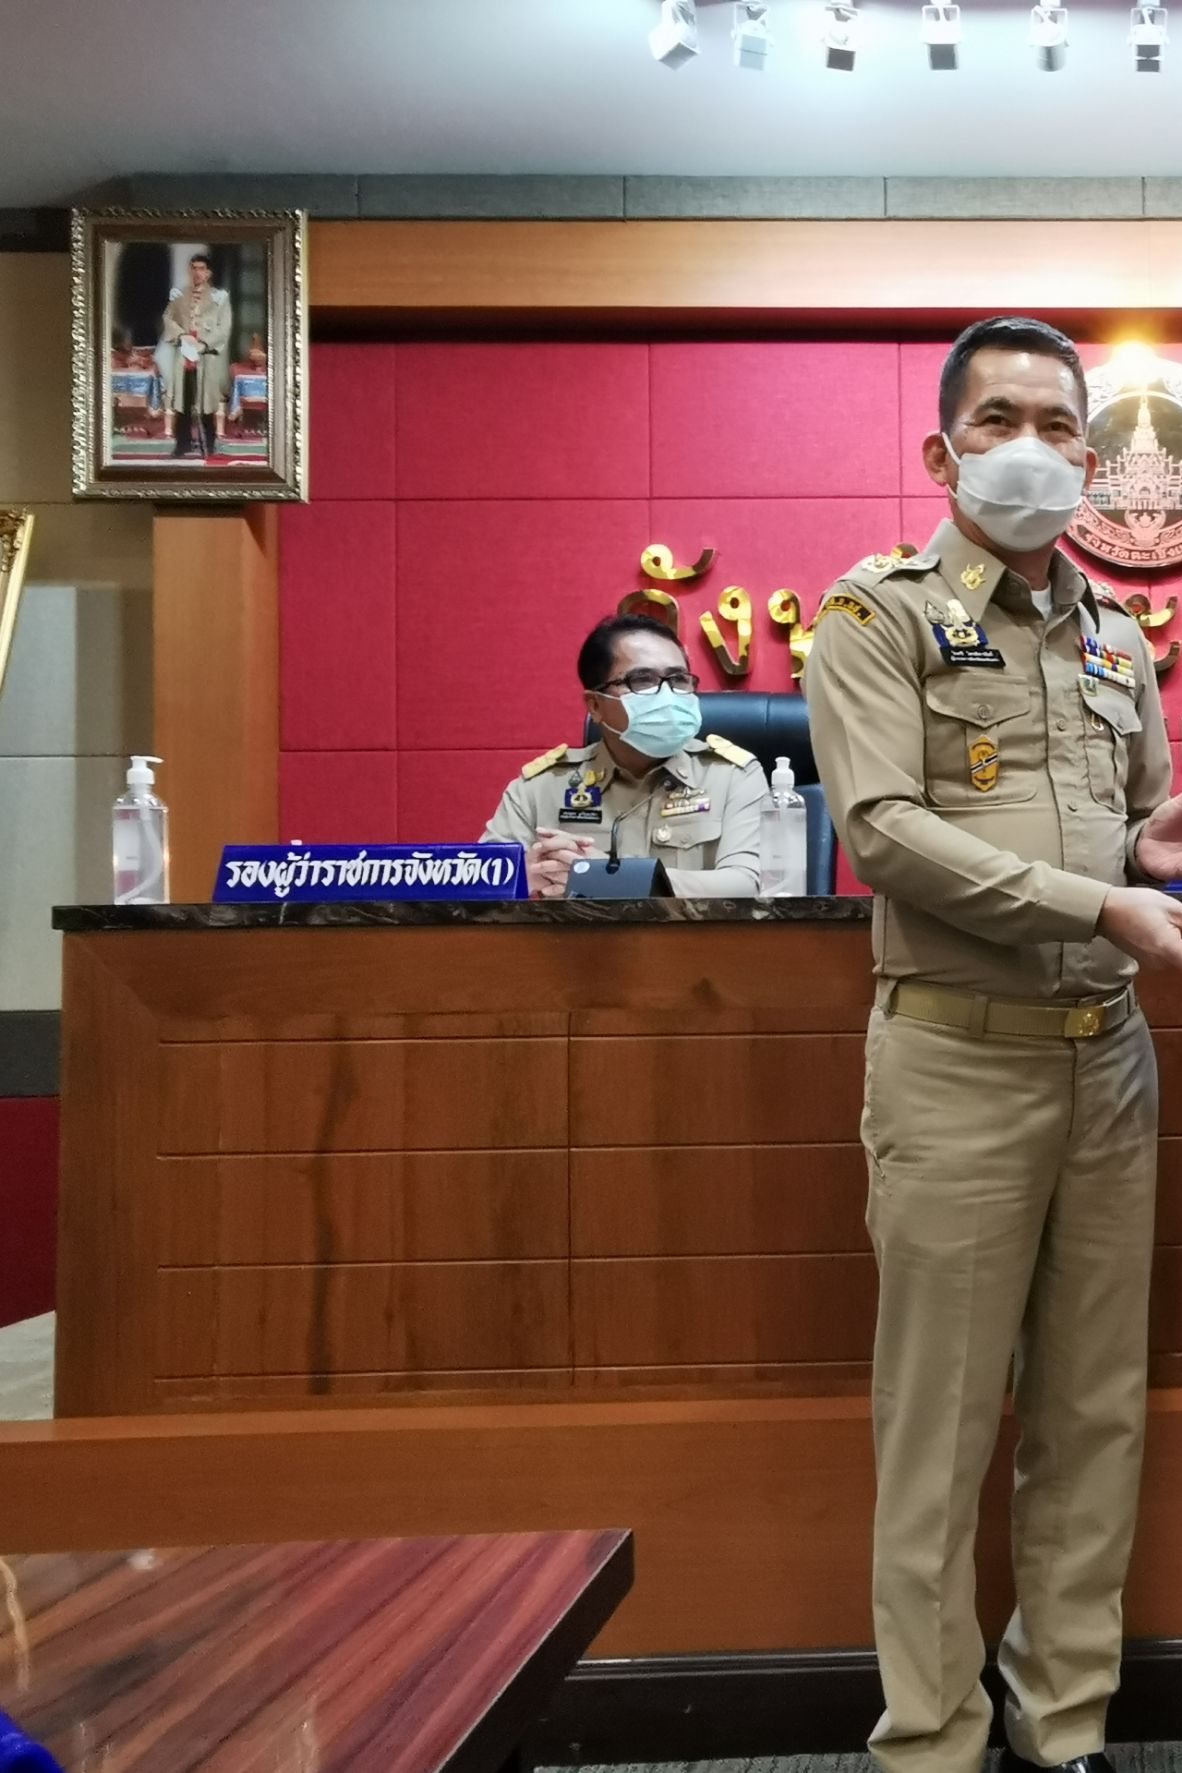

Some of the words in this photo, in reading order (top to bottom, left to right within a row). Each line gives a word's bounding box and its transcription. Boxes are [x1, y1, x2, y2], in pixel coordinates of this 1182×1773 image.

[224, 850, 515, 897] รองผู้ว่าราชการจังหวัด(1)
